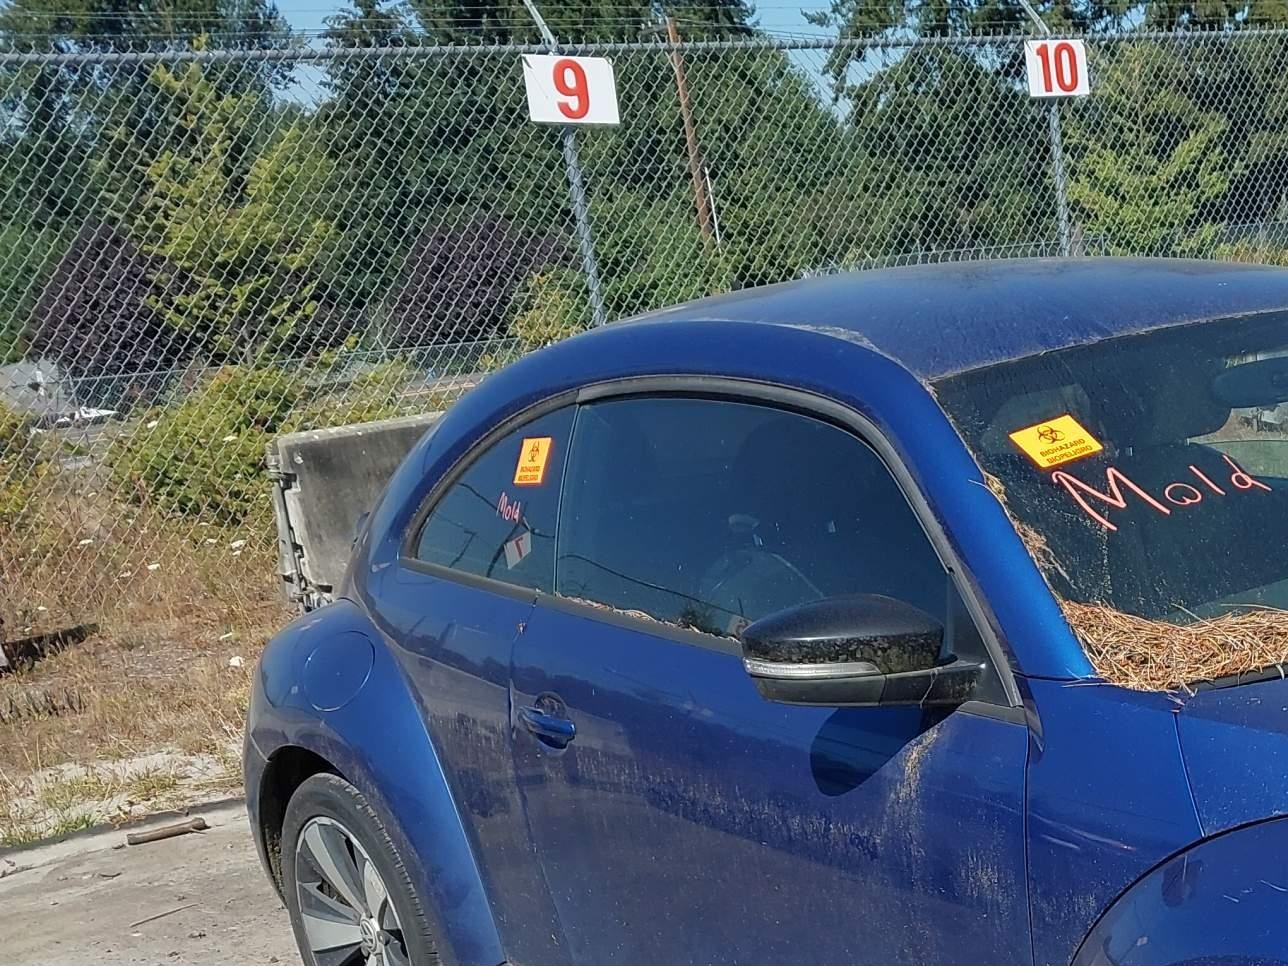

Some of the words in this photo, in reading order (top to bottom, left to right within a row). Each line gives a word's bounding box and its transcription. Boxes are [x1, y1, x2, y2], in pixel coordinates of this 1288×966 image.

[553, 59, 589, 119] 9
[1036, 42, 1078, 92] 10
[1040, 438, 1086, 457] BIOHAZARD
[496, 491, 521, 523] Mold
[1052, 454, 1272, 531] Mold
